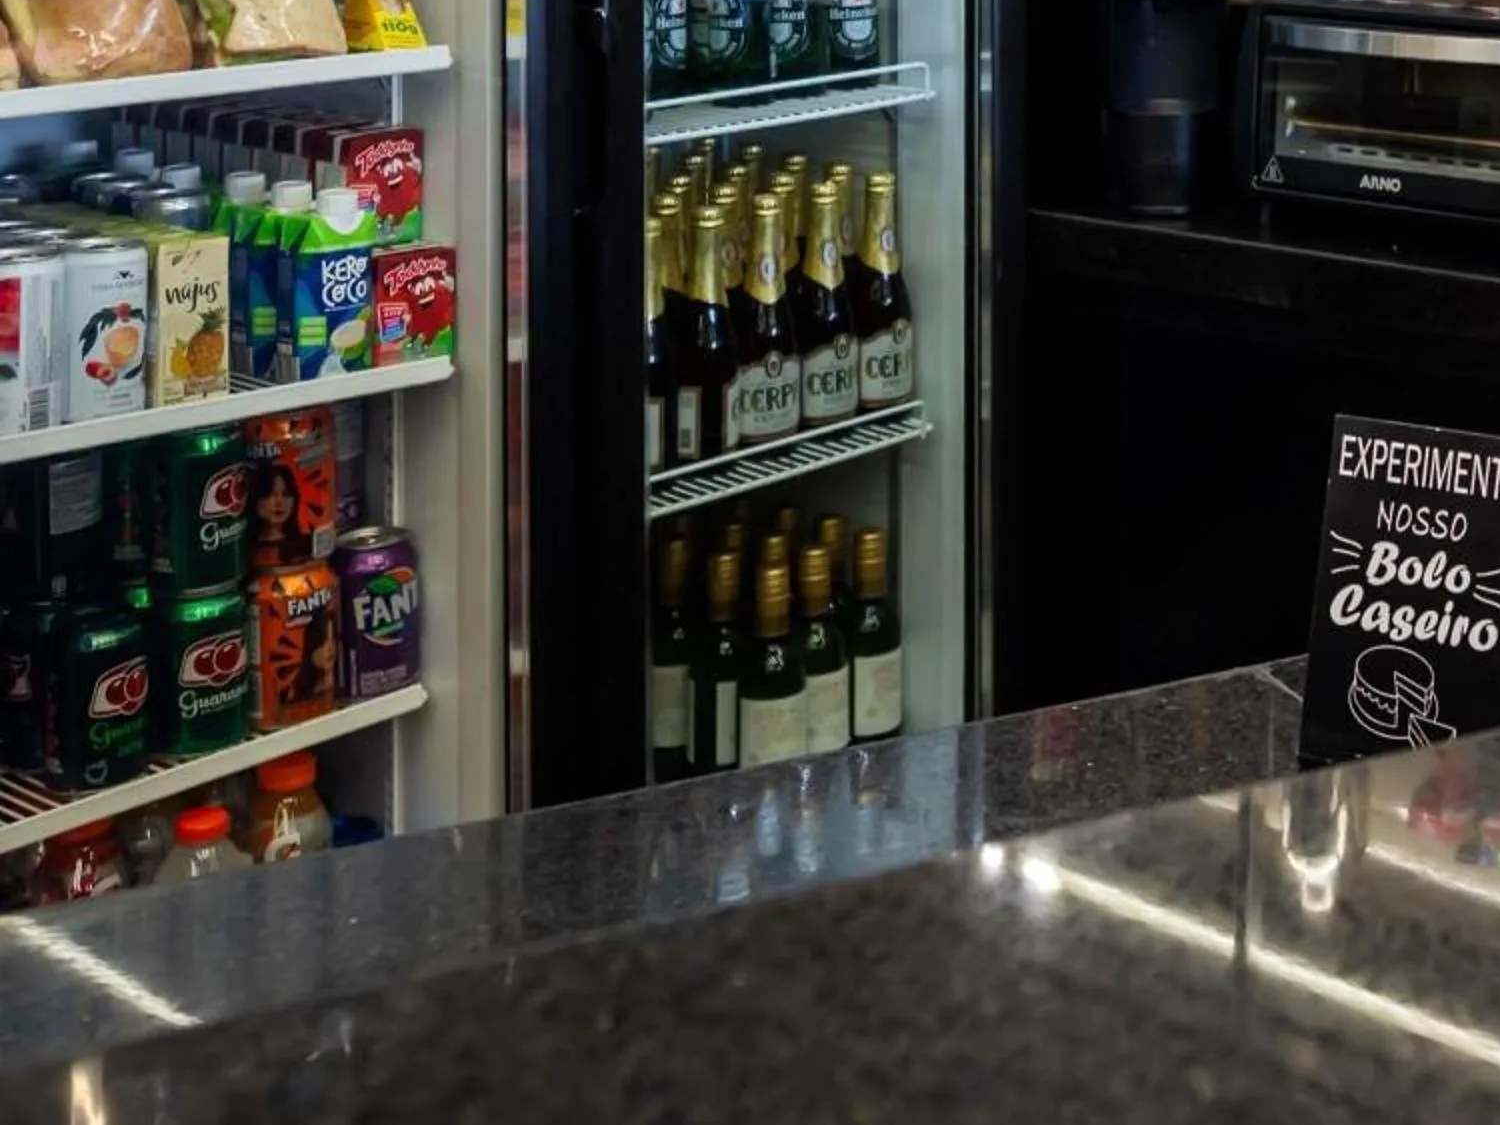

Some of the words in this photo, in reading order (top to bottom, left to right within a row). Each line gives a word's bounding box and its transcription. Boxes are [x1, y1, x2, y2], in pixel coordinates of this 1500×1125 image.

[1359, 174, 1401, 193] ARNO
[321, 254, 369, 285] KERO
[321, 277, 367, 307] COCO
[1377, 499, 1468, 542] NOSSO
[1366, 540, 1471, 594] Bolo
[353, 579, 418, 630] FANT
[1329, 584, 1499, 652] Caseiro
